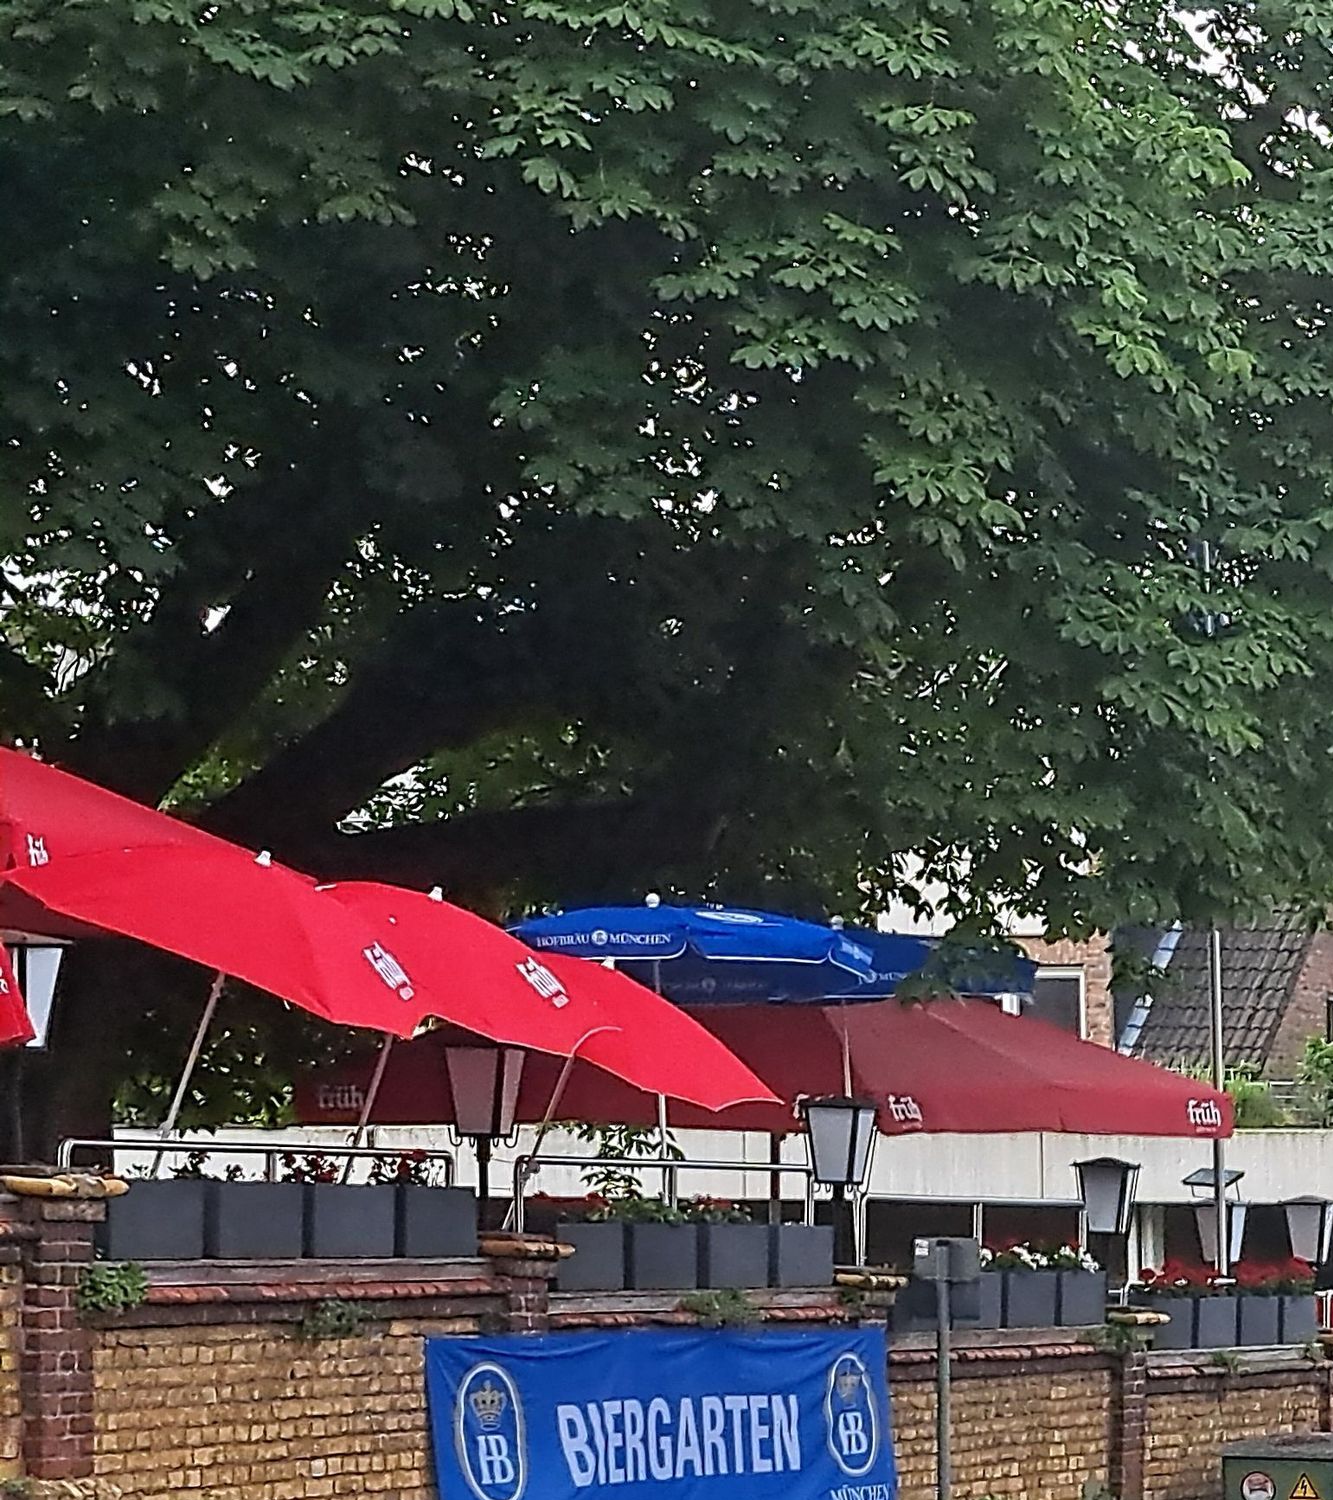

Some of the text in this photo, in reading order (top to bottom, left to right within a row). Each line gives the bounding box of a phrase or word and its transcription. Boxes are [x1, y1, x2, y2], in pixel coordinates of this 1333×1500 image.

[609, 932, 671, 945] MÜNCHEN
[1187, 1099, 1221, 1127] früh
[477, 1435, 514, 1485] HB
[557, 1395, 801, 1487] BIERGARTEN
